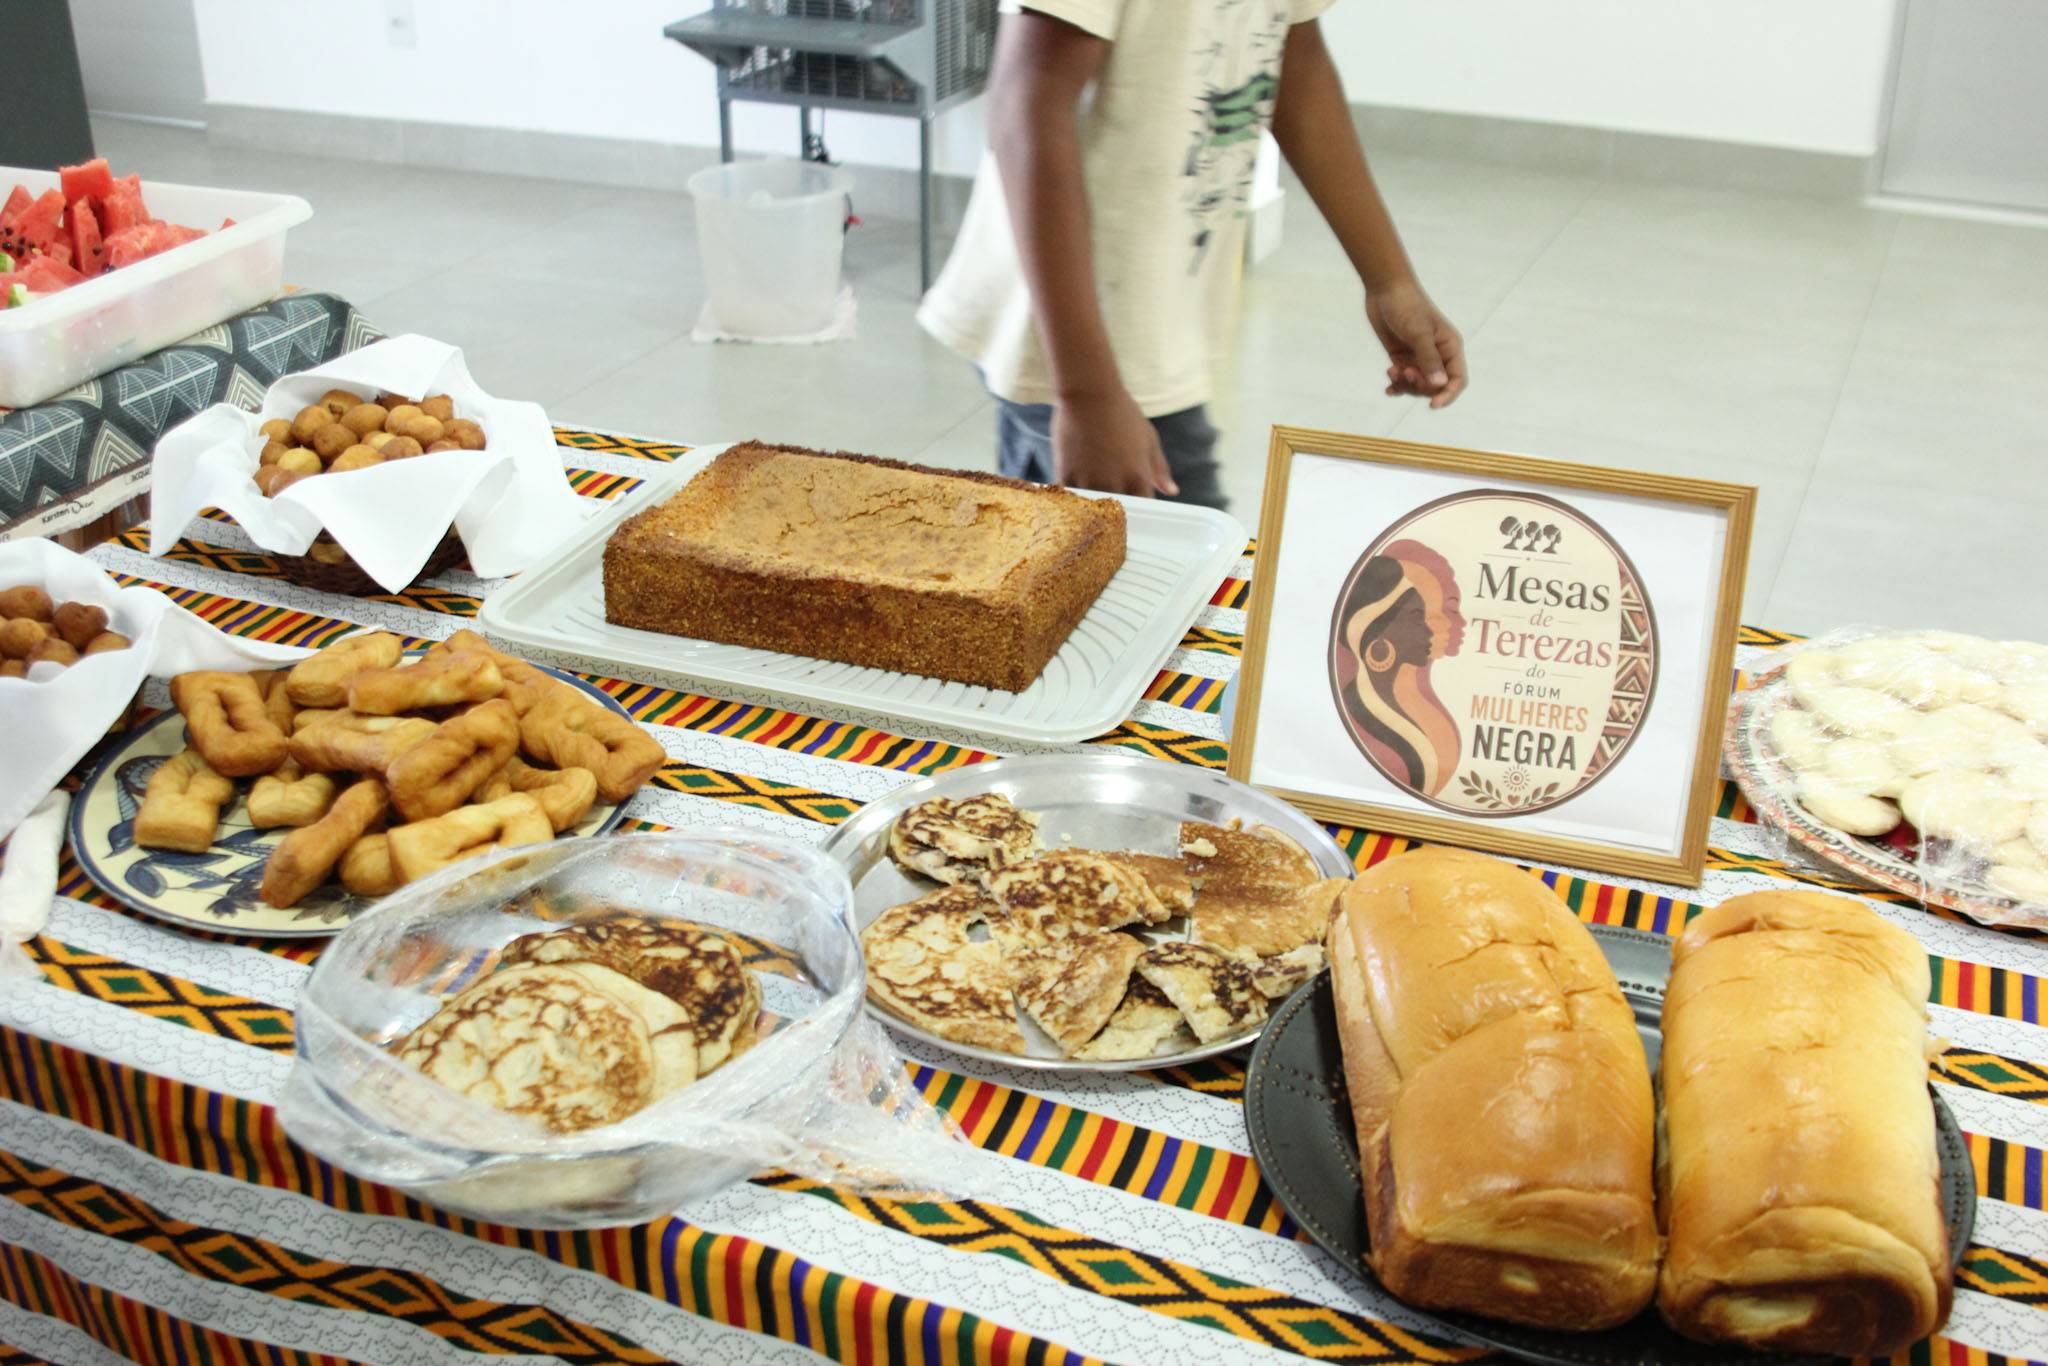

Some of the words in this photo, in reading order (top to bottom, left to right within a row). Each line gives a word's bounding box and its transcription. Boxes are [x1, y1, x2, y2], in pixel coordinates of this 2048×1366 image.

[1474, 563, 1610, 612] Mesas
[1530, 609, 1553, 627] de
[1472, 618, 1612, 668] Terezas
[1526, 664, 1546, 679] do
[1471, 695, 1589, 732] MULHERES
[1473, 725, 1576, 771] NEGRA
